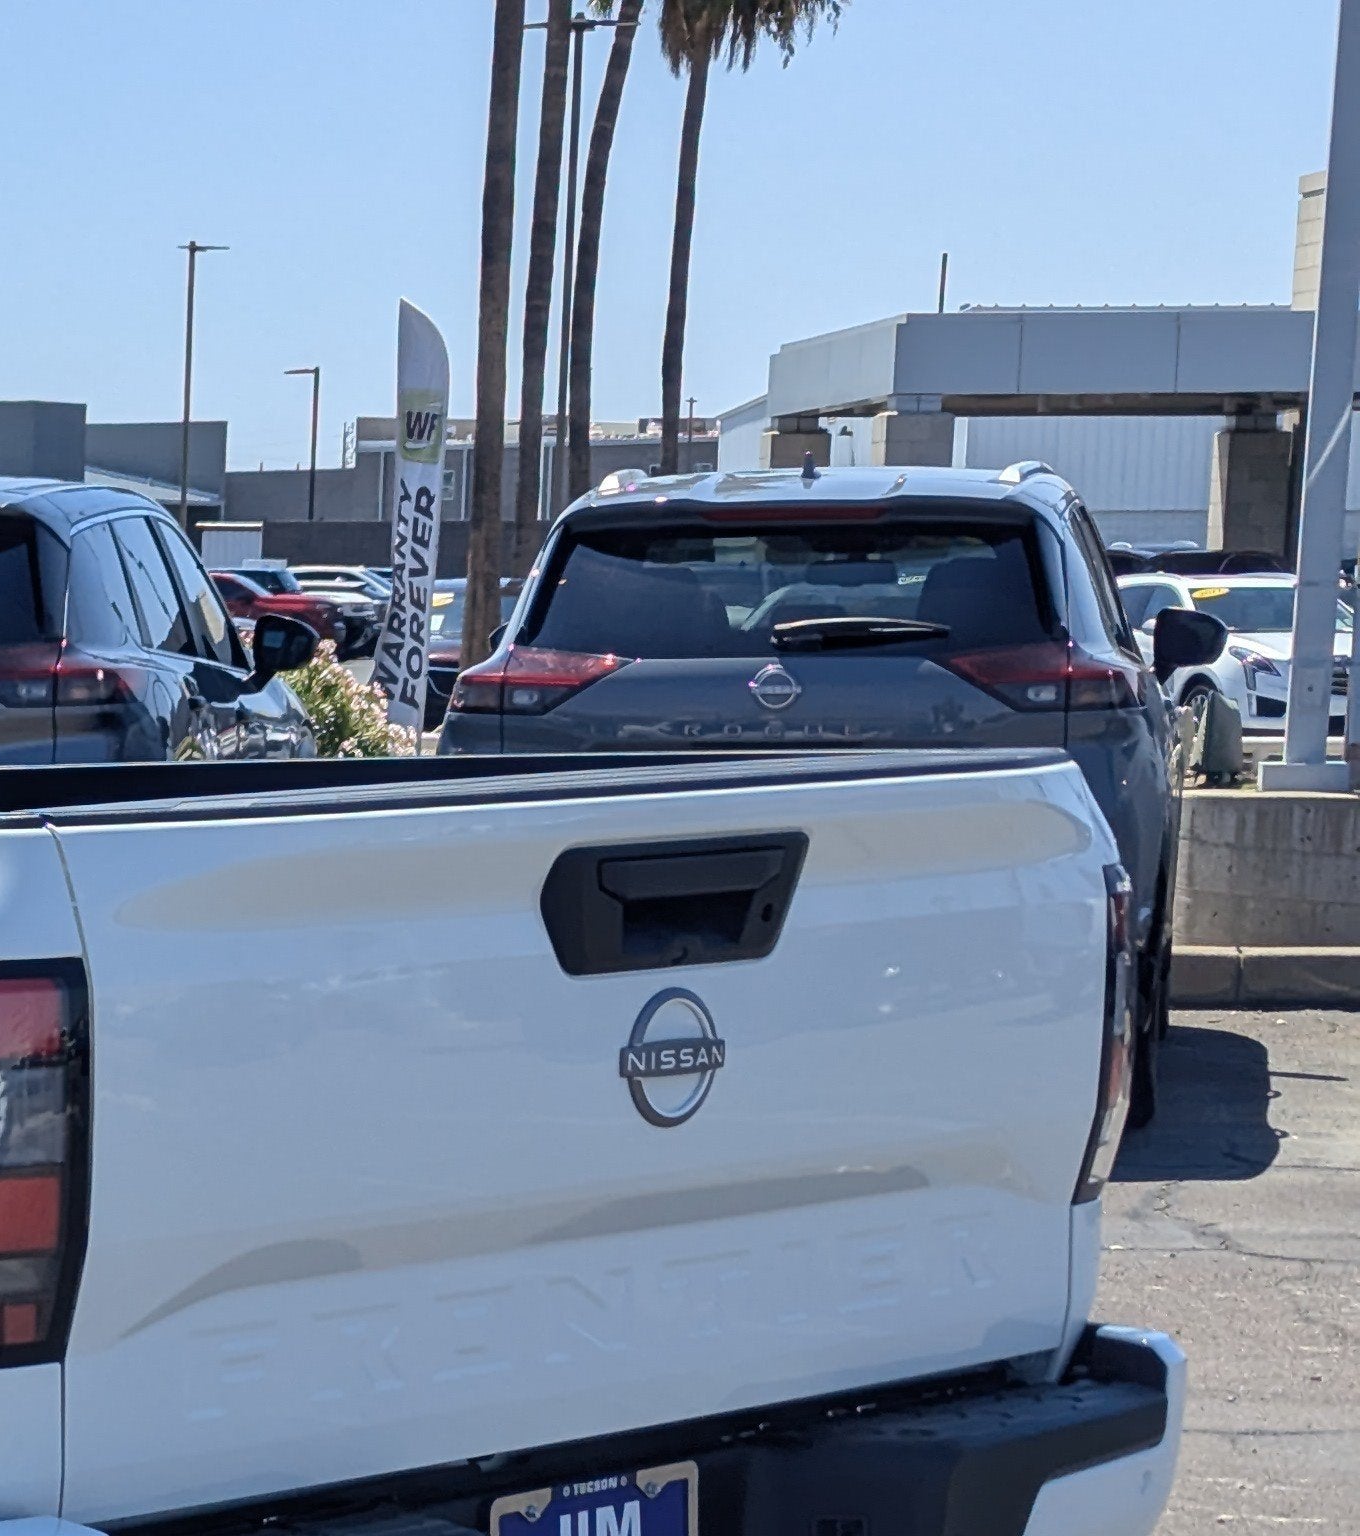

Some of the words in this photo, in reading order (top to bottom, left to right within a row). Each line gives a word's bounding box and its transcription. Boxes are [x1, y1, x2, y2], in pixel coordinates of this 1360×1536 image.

[375, 478, 412, 700] WARRANTY
[399, 486, 435, 709] FOREVER
[626, 1045, 724, 1072] NISSAN
[572, 1476, 619, 1496] TUCSON
